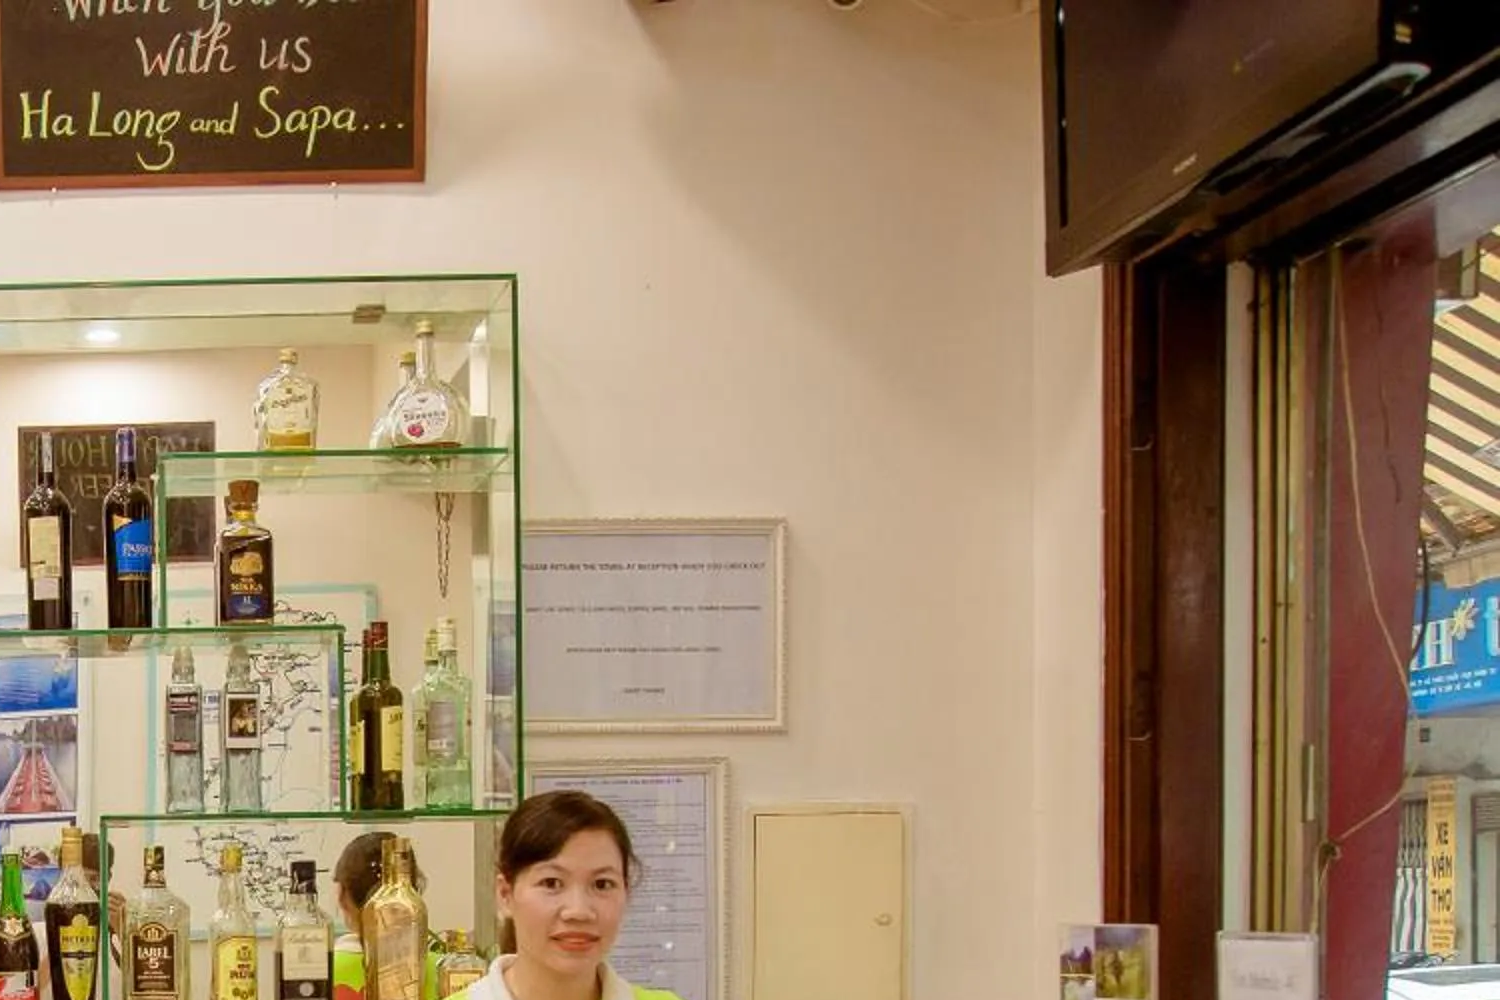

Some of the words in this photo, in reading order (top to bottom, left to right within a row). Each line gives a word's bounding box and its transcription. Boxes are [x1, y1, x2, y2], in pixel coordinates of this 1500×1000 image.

[259, 36, 312, 73] us
[19, 89, 76, 141] Ha
[88, 90, 182, 172] Long
[189, 101, 239, 136] and
[137, 946, 173, 960] LABEL
